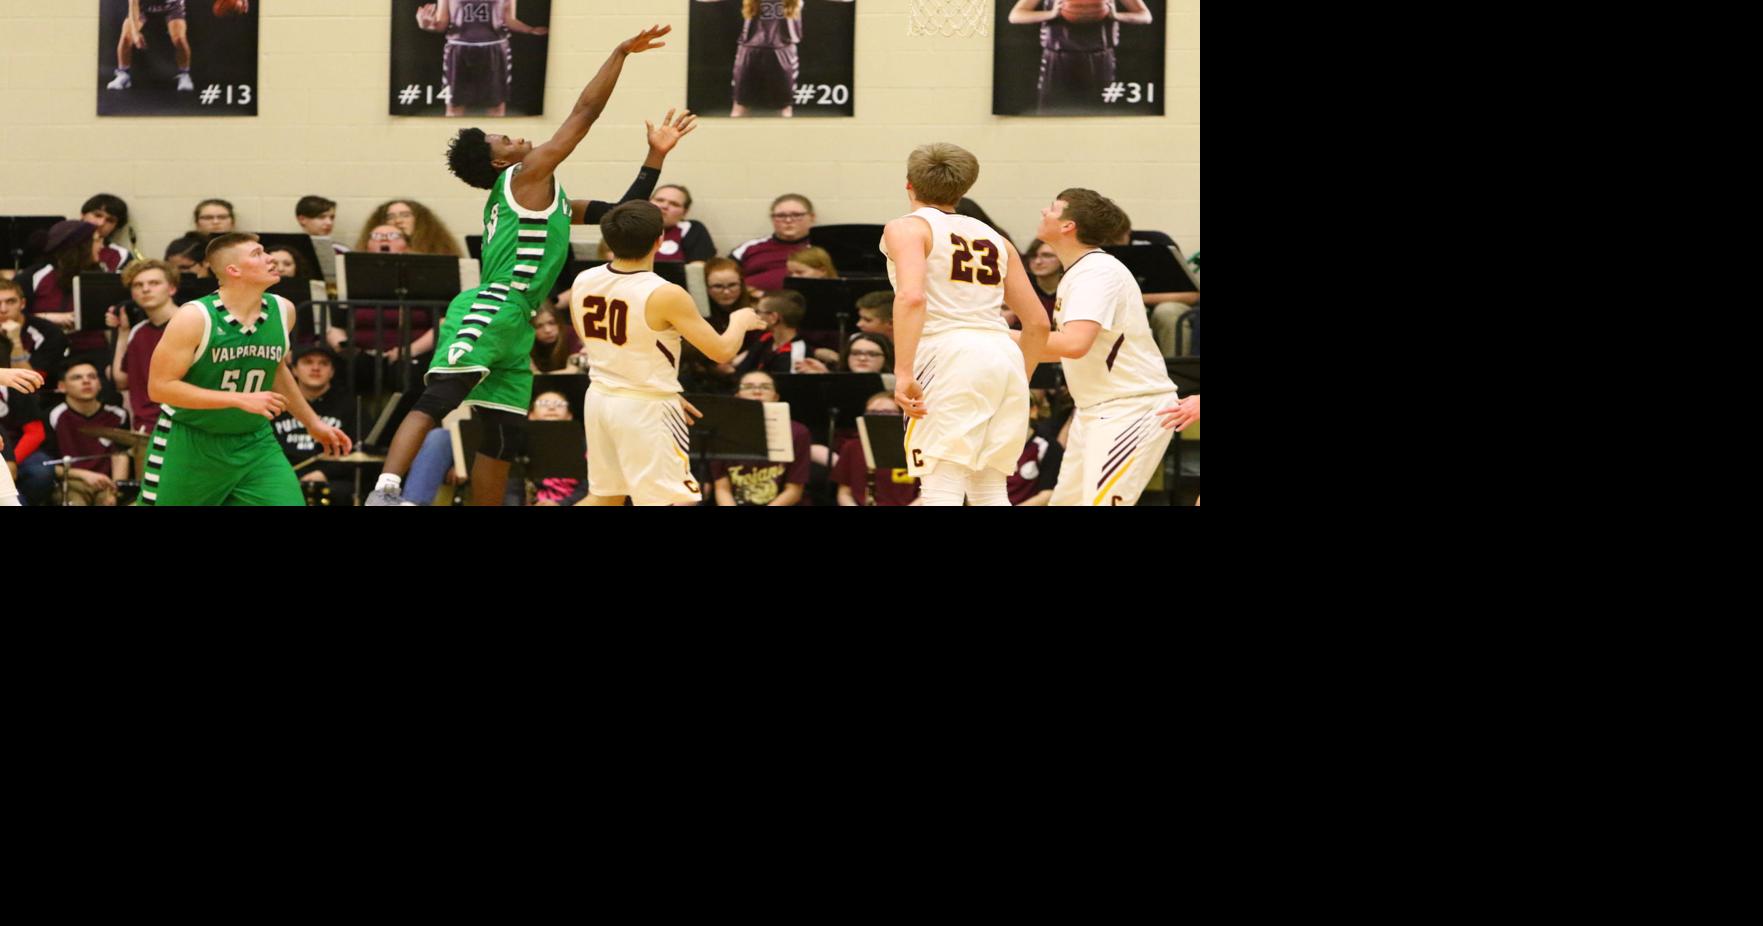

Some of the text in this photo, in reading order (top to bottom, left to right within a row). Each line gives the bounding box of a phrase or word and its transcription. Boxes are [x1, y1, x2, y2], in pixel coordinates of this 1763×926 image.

[464, 3, 489, 22] 14
[200, 84, 252, 105] #13
[398, 84, 453, 105] #14
[793, 84, 849, 105] #20
[1101, 82, 1154, 103] #31
[950, 232, 1001, 285] 23
[583, 295, 628, 346] 20
[211, 345, 282, 364] VALPARAISO
[221, 369, 266, 393] 50
[912, 448, 924, 468] C
